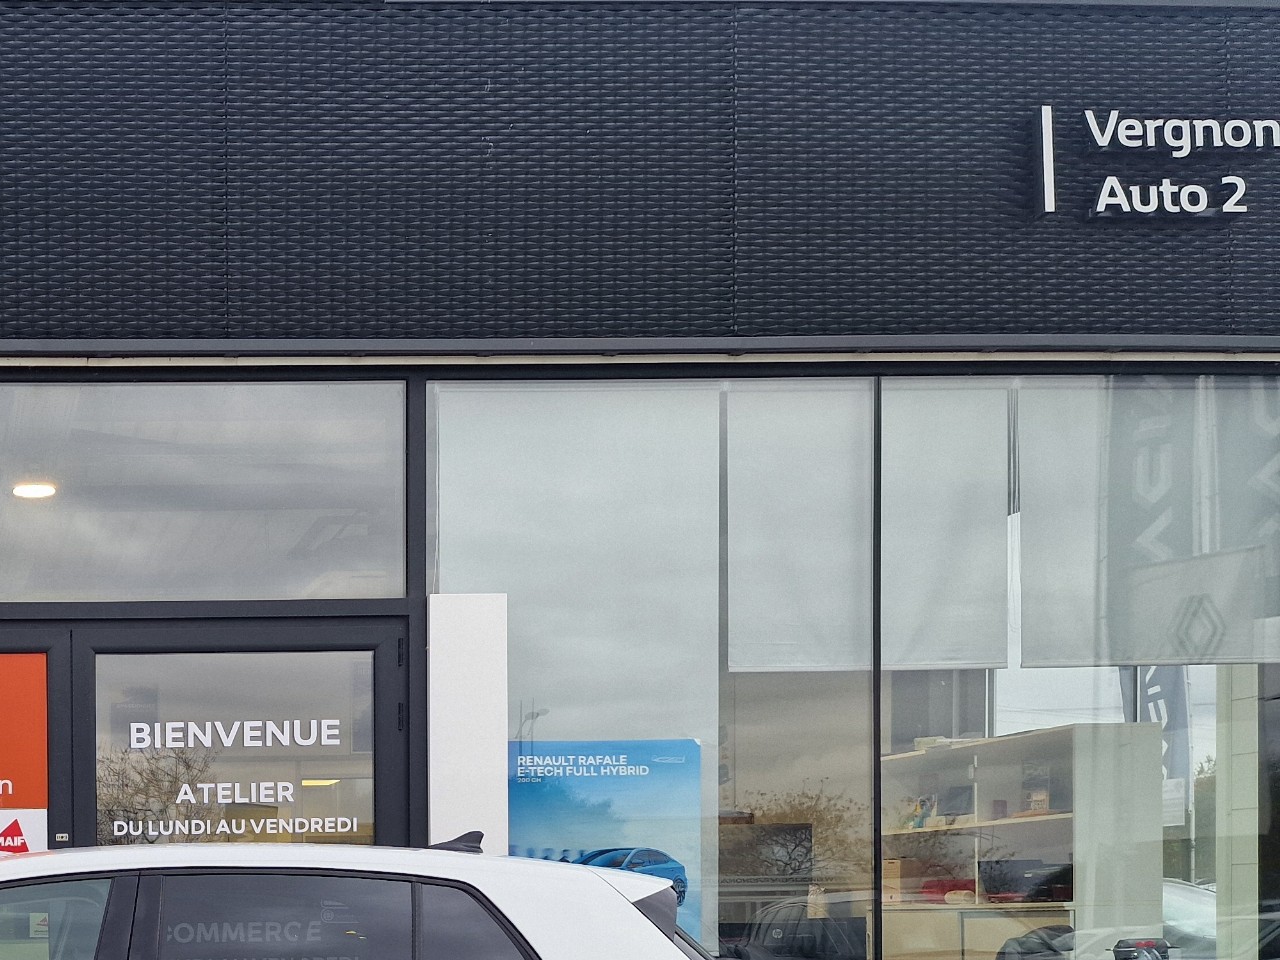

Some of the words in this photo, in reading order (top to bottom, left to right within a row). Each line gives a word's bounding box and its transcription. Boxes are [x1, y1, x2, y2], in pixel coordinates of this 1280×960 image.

[1084, 110, 1280, 157] Vergnon
[1096, 176, 1208, 213] Auto
[1221, 176, 1248, 213] 2
[130, 719, 341, 749] BIENVENUE
[517, 755, 575, 766] RENAULT
[578, 755, 627, 765] RAFALE
[517, 766, 563, 777] E-TECH
[566, 766, 598, 776] FULL
[601, 765, 649, 776] HYBRID
[176, 781, 294, 804] ATELIER
[113, 820, 143, 836] DU
[148, 820, 211, 836] LUNDI
[216, 819, 246, 835] AU
[250, 817, 358, 834] VENDREDI
